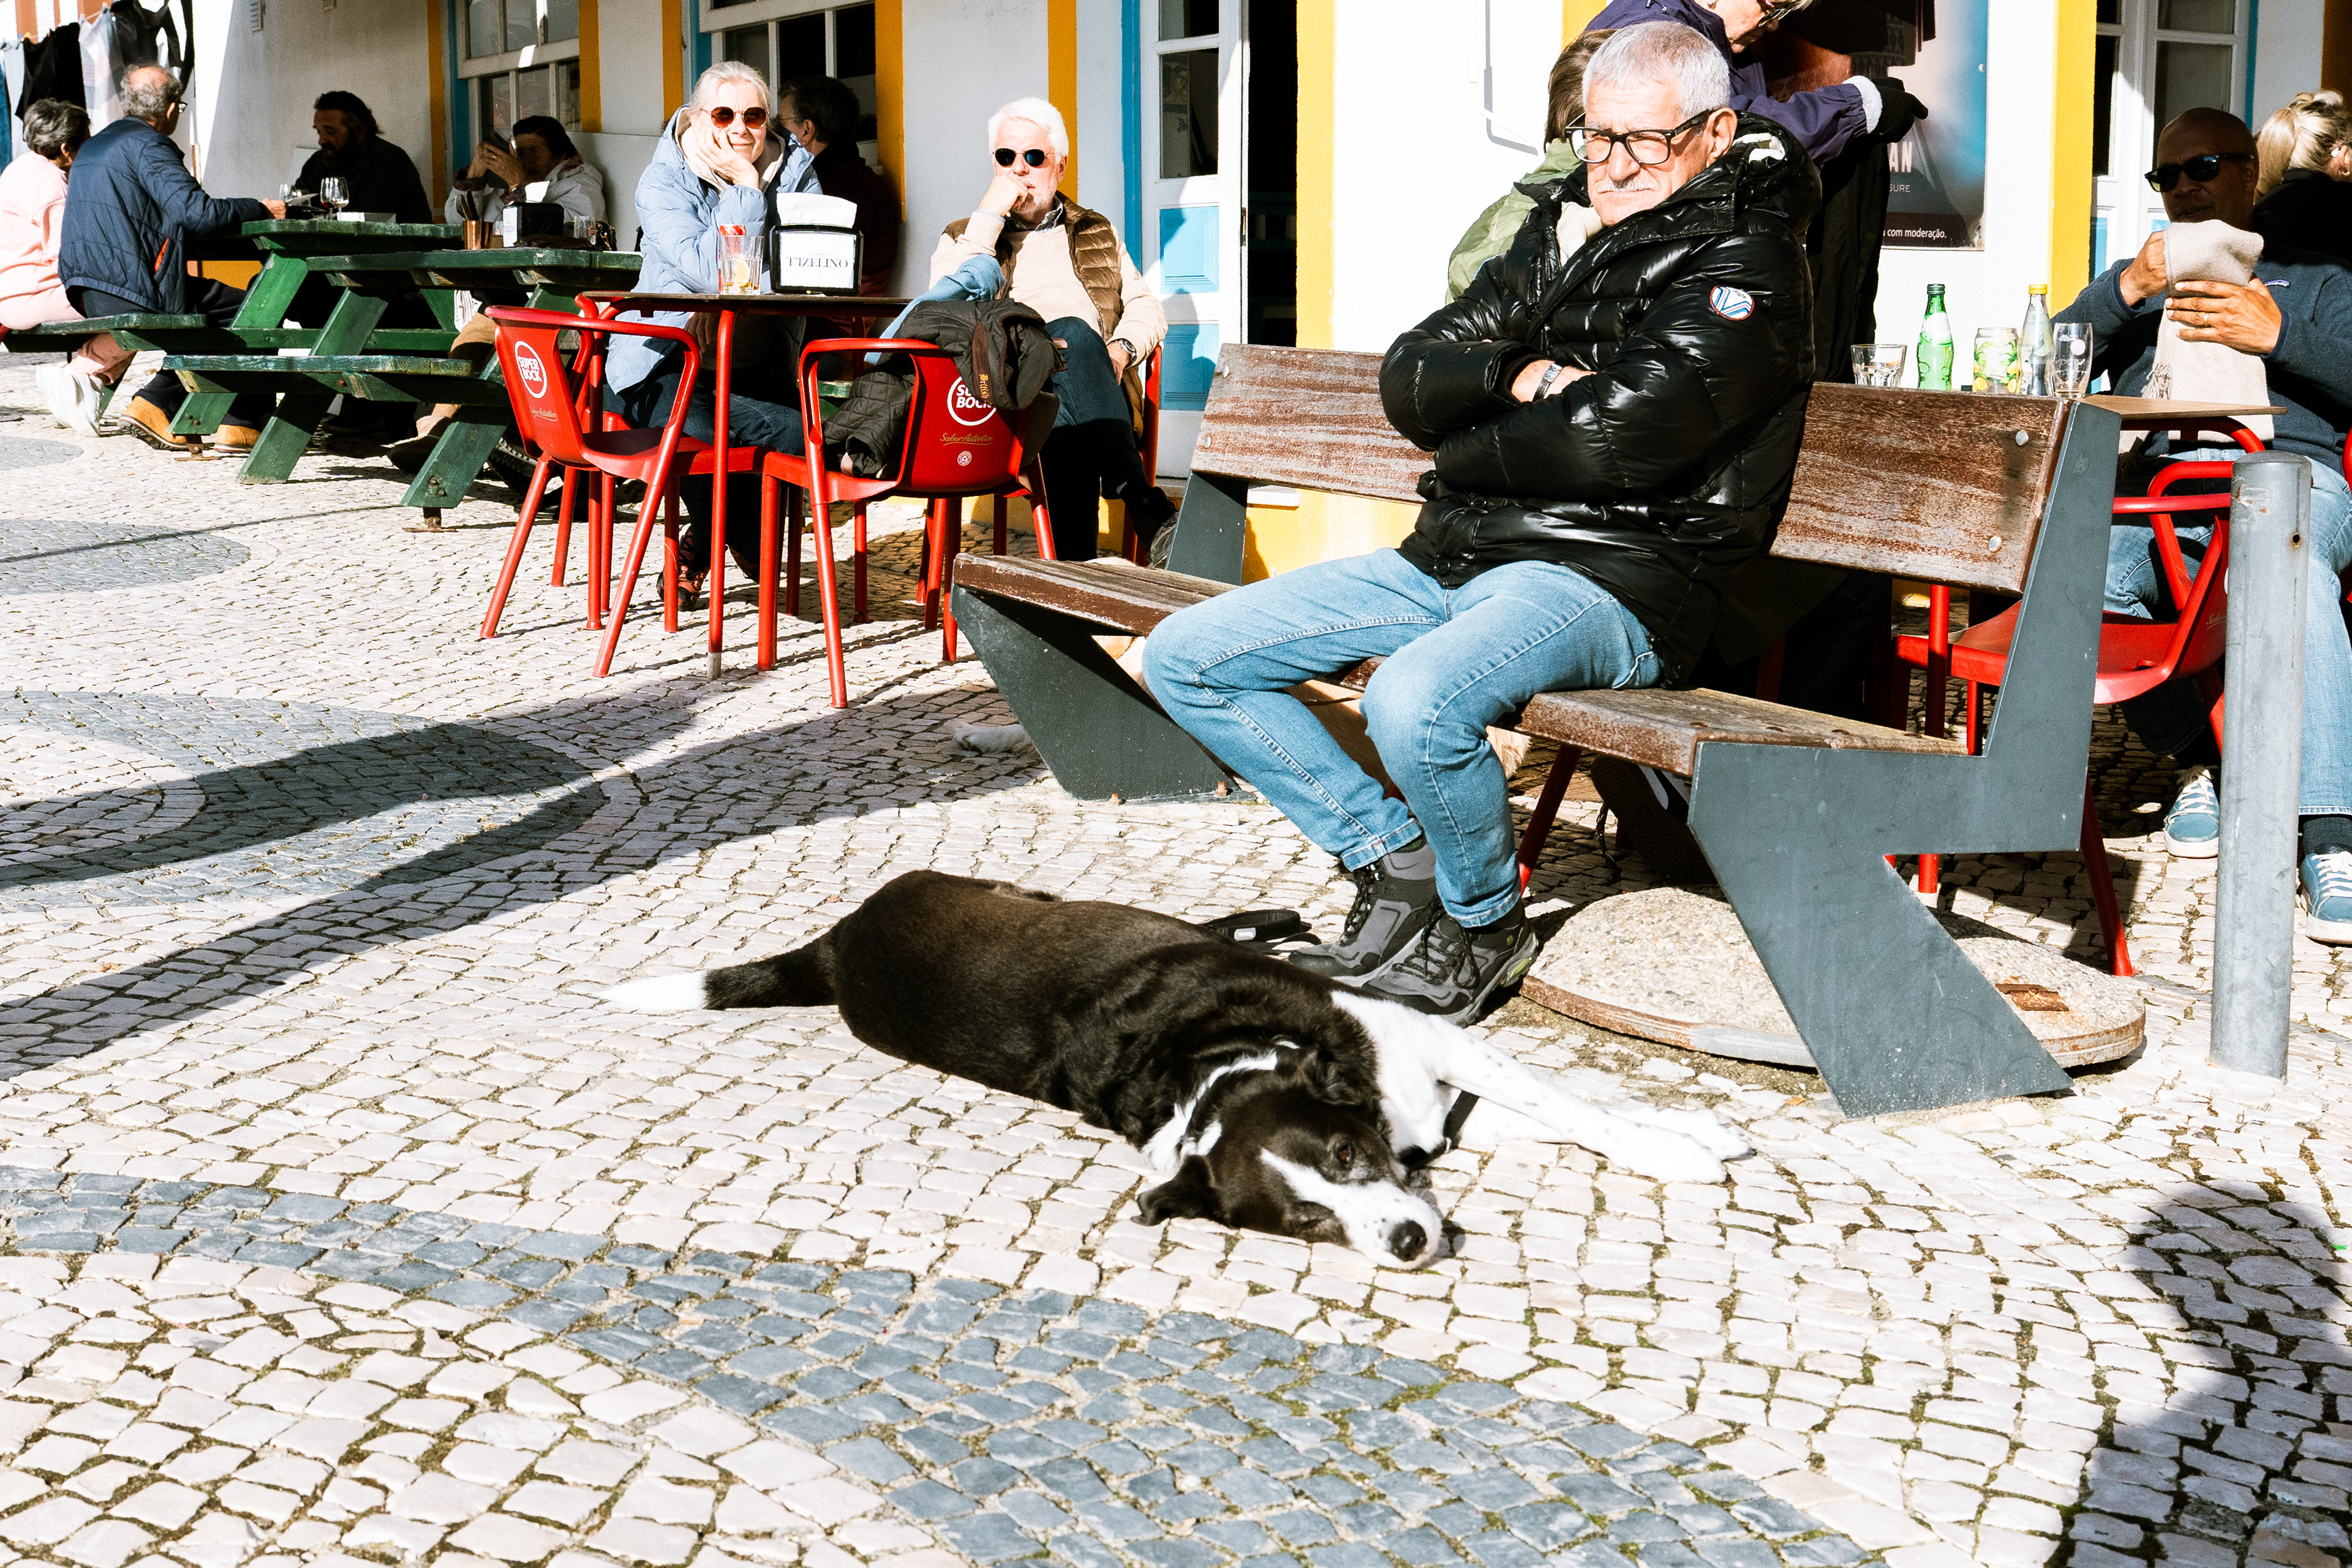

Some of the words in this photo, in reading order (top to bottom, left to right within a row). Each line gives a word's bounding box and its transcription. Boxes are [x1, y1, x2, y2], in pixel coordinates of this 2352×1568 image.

[1904, 227, 1947, 240] moderação.
[518, 356, 540, 370] SUPER
[522, 368, 543, 382] BOCK
[940, 432, 963, 442] Sabor
